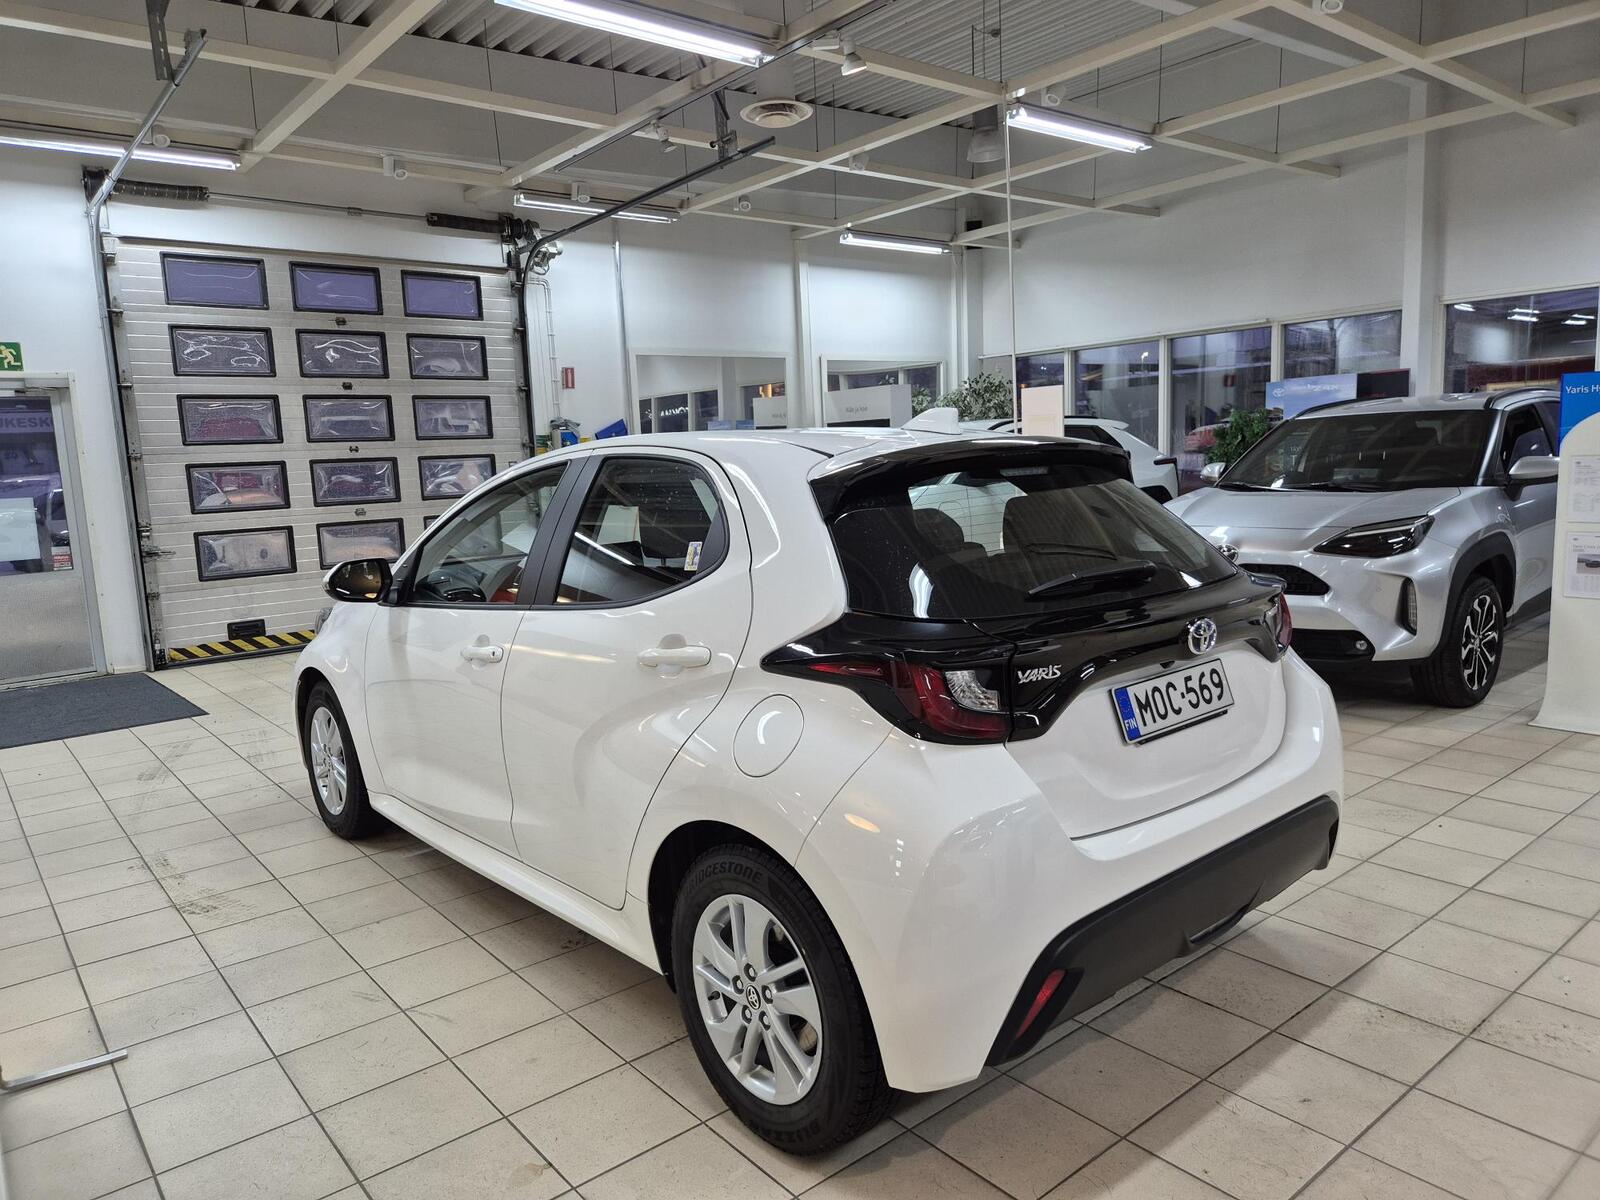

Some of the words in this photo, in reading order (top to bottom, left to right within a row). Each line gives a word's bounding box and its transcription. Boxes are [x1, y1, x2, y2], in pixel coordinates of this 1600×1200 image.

[1565, 385, 1589, 394] Yaris
[1017, 664, 1062, 684] YARIS
[1133, 667, 1224, 727] MOC-569
[1124, 718, 1138, 732] FIN
